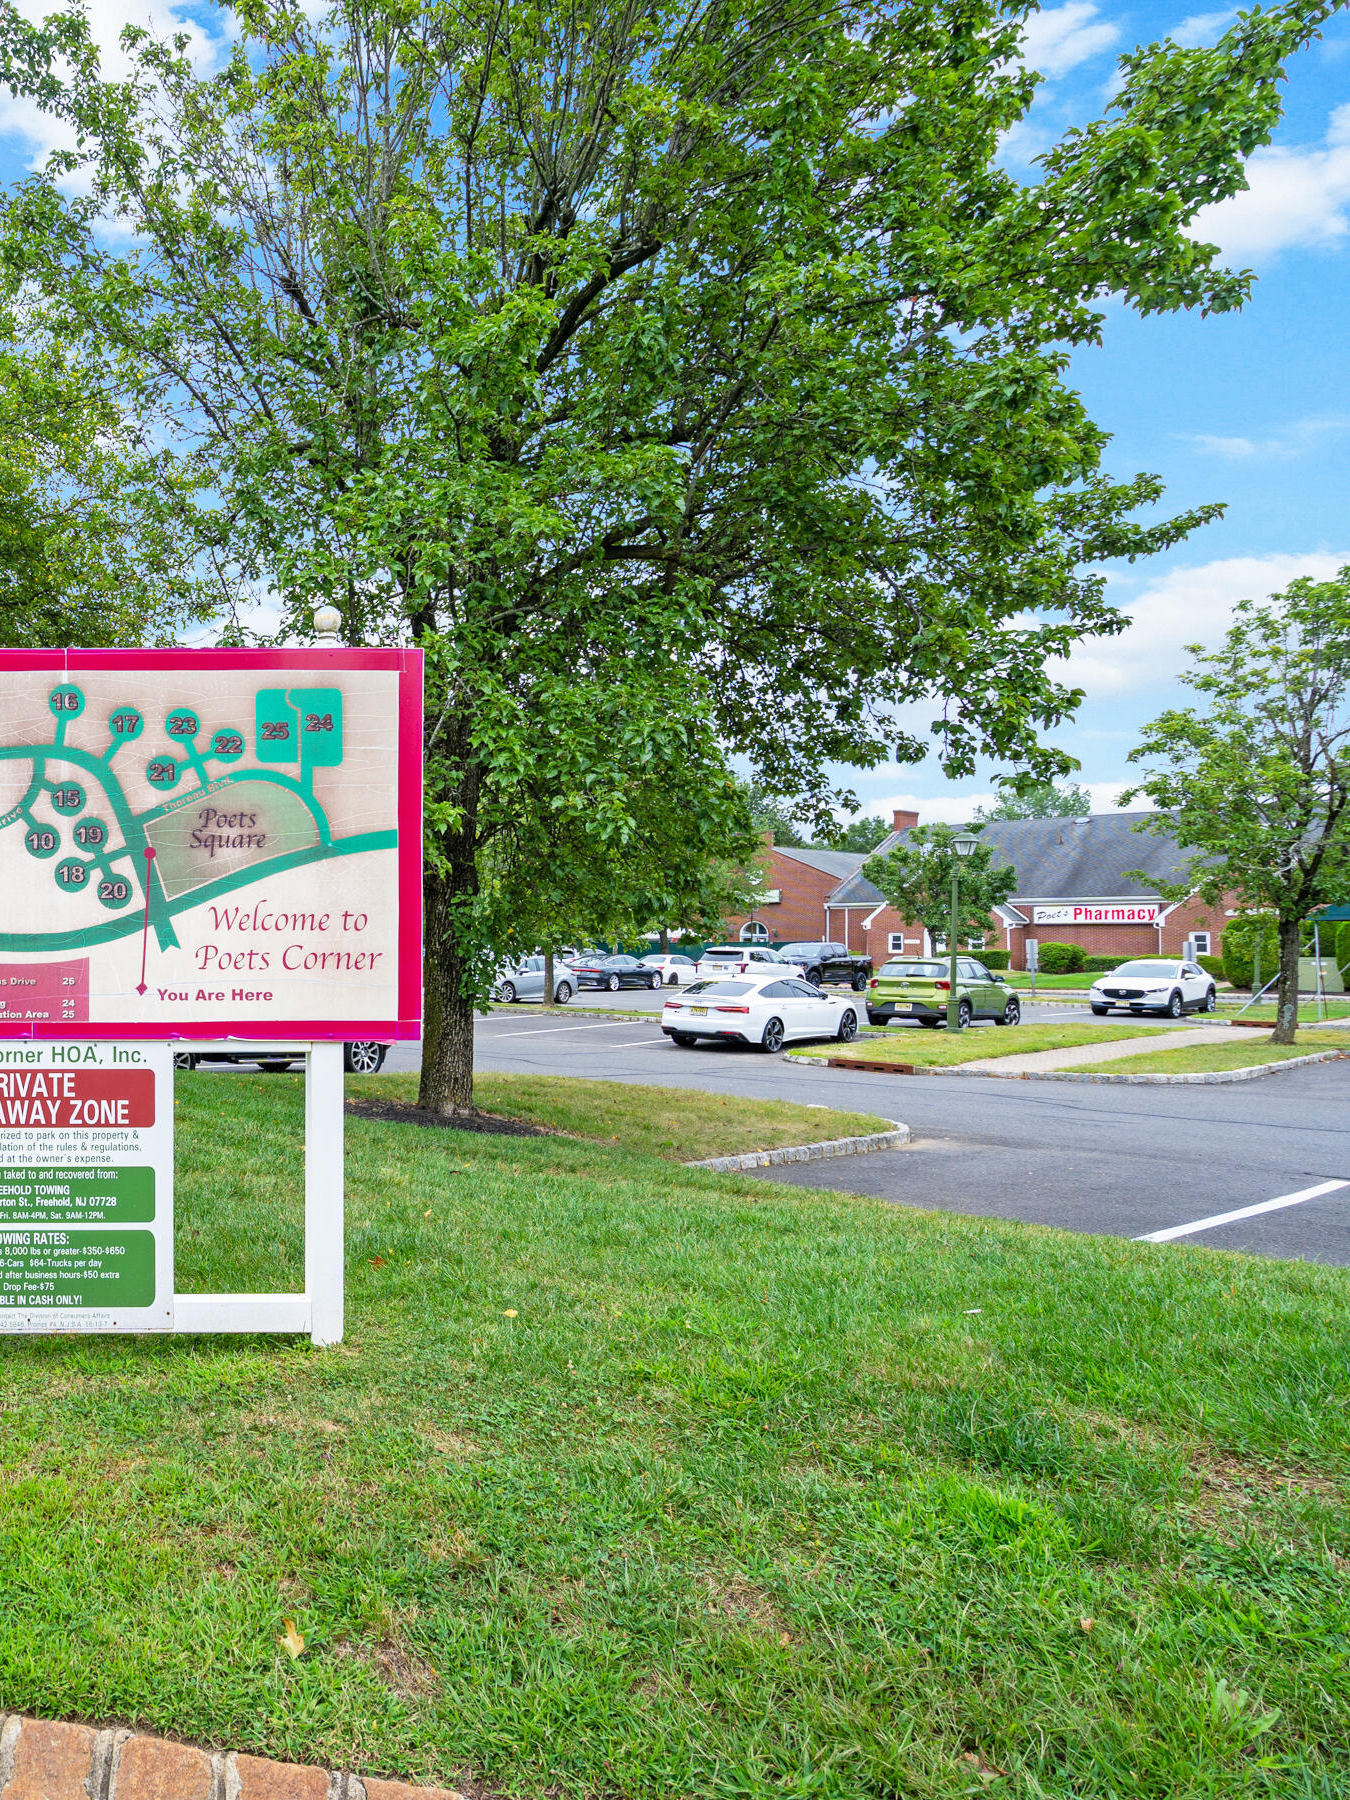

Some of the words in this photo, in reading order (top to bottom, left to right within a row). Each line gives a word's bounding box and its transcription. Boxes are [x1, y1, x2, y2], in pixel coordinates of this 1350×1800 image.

[51, 694, 78, 710] 16
[112, 716, 139, 732] 17
[169, 717, 197, 734] 23
[261, 722, 289, 739] 25
[305, 714, 333, 731] 24
[214, 736, 242, 753] 22
[150, 763, 175, 780] 21
[207, 776, 234, 792] Blvd.
[54, 790, 80, 807] 15
[199, 809, 256, 828] Poets
[28, 833, 54, 849] 10
[76, 827, 103, 843] 19
[189, 829, 266, 856] Square
[58, 866, 85, 882] 18
[100, 882, 127, 899] 20
[208, 900, 330, 932] Welcome
[342, 910, 368, 932] to
[1037, 908, 1068, 921] Poet's
[1074, 908, 1155, 921] Pharmacy
[195, 945, 270, 970] Poets
[282, 945, 383, 970] Corner
[11, 978, 37, 986] Drive
[158, 989, 188, 1001] You
[196, 990, 225, 1000] Are
[232, 989, 273, 1001] Here
[25, 1011, 50, 1019] Area
[52, 1046, 103, 1065] HOA,
[114, 1046, 146, 1062] Inc.
[70, 1100, 129, 1124] ZONE
[37, 1131, 55, 1141] park
[73, 1131, 89, 1139] this
[93, 1132, 128, 1141] property
[133, 1130, 138, 1139] &
[28, 1143, 35, 1151] of
[40, 1143, 53, 1151] the
[57, 1143, 77, 1151] rules
[81, 1142, 87, 1151] &
[91, 1143, 141, 1153] regulations,
[19, 1154, 32, 1162] the
[36, 1154, 71, 1162] owner's
[75, 1156, 113, 1164] expense.
[4, 1169, 25, 1179] taked
[28, 1171, 36, 1179] to
[39, 1169, 53, 1179] and
[56, 1169, 94, 1179] recovered
[97, 1169, 118, 1179] from:
[34, 1186, 70, 1195] TOWING
[19, 1197, 33, 1207] St.,
[36, 1197, 72, 1207] Freehold,
[76, 1197, 86, 1206] NJ
[89, 1197, 116, 1206] 07728
[33, 1233, 70, 1245] RATES:
[5, 1247, 28, 1256] 8,000
[31, 1247, 41, 1255] lbs
[53, 1247, 125, 1257] greater-$350-$650
[4, 1283, 21, 1292] Drop
[24, 1282, 54, 1290] Fee-$75
[18, 1294, 27, 1304] IN
[29, 1294, 53, 1304] CASH
[55, 1295, 82, 1304] ONLY!
